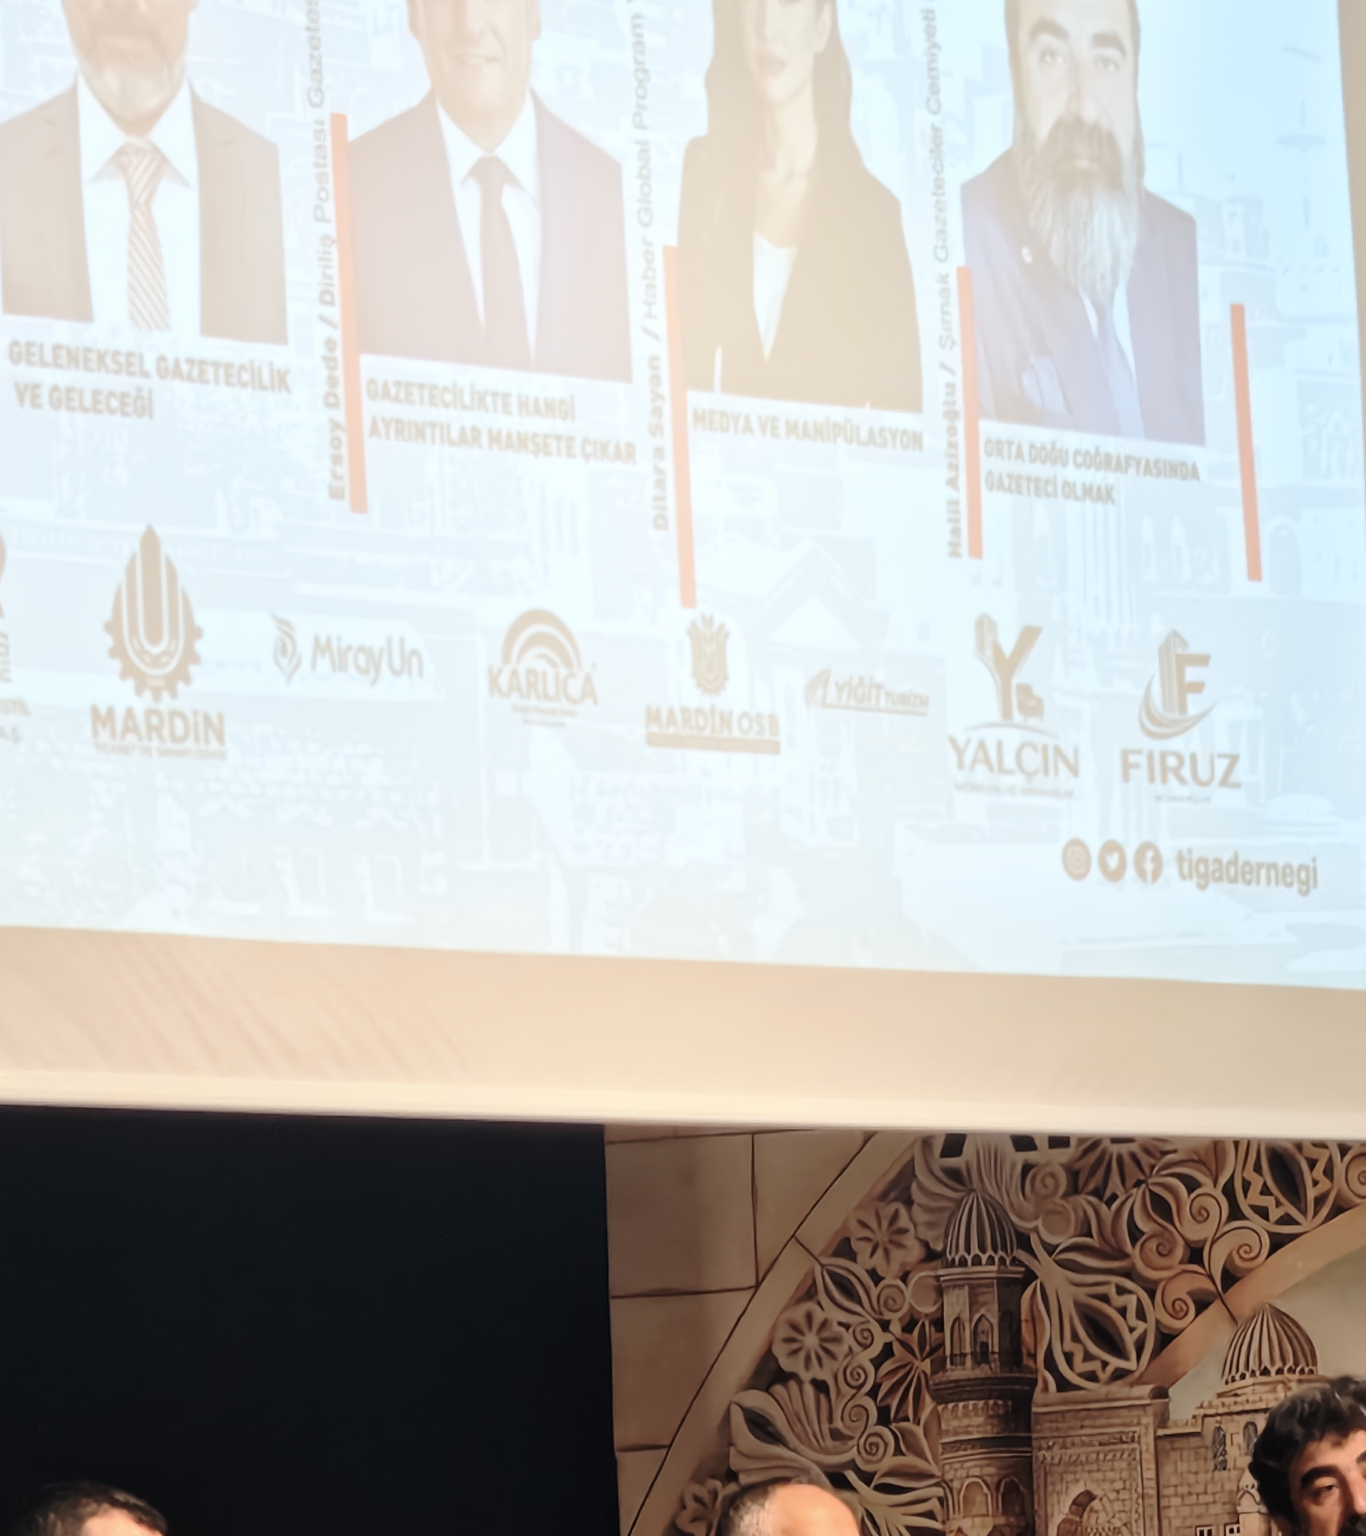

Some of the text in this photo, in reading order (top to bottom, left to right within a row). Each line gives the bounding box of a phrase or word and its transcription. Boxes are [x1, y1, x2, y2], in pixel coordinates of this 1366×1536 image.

[630, 13, 651, 130] Program
[635, 138, 655, 229] Global
[8, 340, 292, 395] GELENEKSEL GAZETECİLİK
[14, 381, 154, 420] VE GELECEĞİ
[366, 377, 576, 422] GAZETECİLİKTE HANGİ
[368, 415, 484, 449] AYRINTILAR
[580, 437, 638, 465] ÇIKAR
[692, 407, 923, 452] MEDYA VE MANİPÜLASYON
[985, 437, 1201, 482] ORTA DOĞU COĞRAFYASINDA
[985, 470, 1116, 504] GAZETECİ OLMAK
[309, 632, 426, 687] MirayUn
[89, 702, 226, 747] MARDİN
[645, 702, 781, 738] MARDİN OSB
[1119, 746, 1243, 790] FIRUZ
[1175, 847, 1319, 899] tigadernegi
